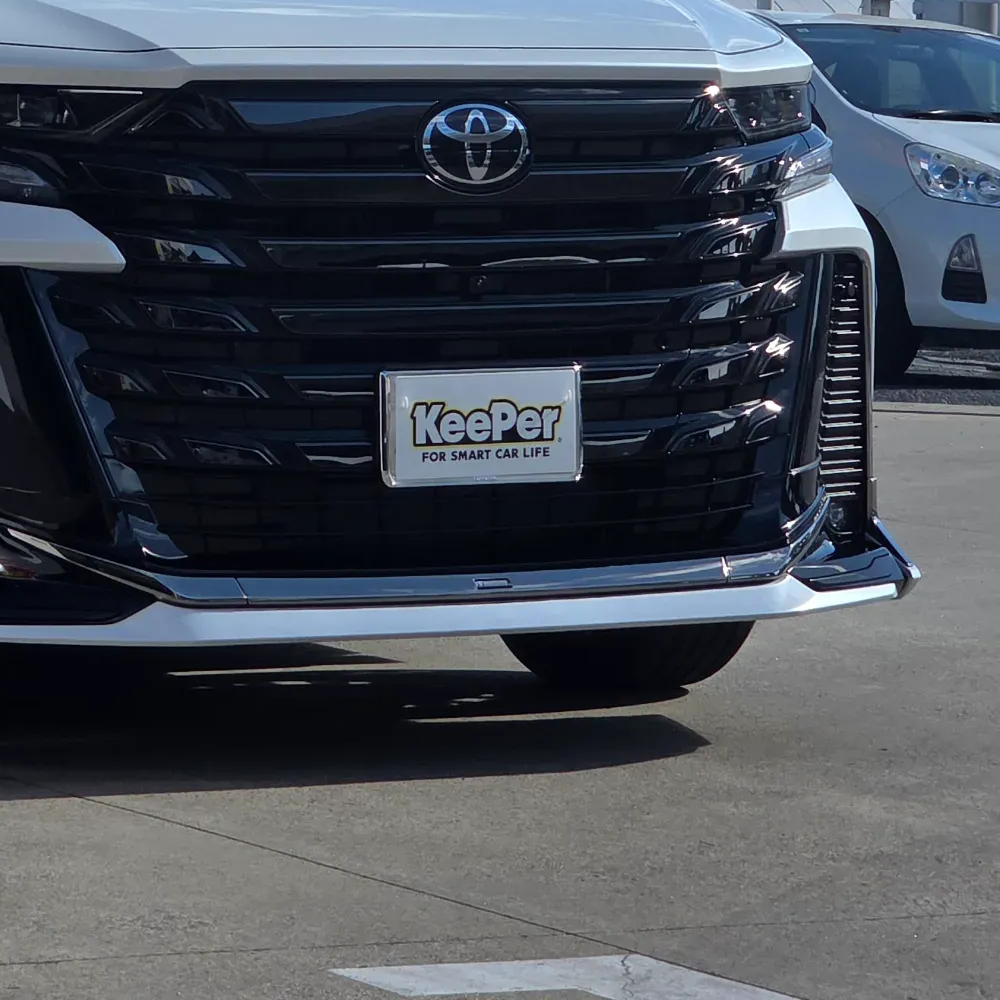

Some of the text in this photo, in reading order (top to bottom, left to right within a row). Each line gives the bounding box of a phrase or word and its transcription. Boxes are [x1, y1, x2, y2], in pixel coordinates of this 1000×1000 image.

[410, 398, 562, 447] KeePer
[421, 446, 550, 463] FOR SMART CAR LIFE
